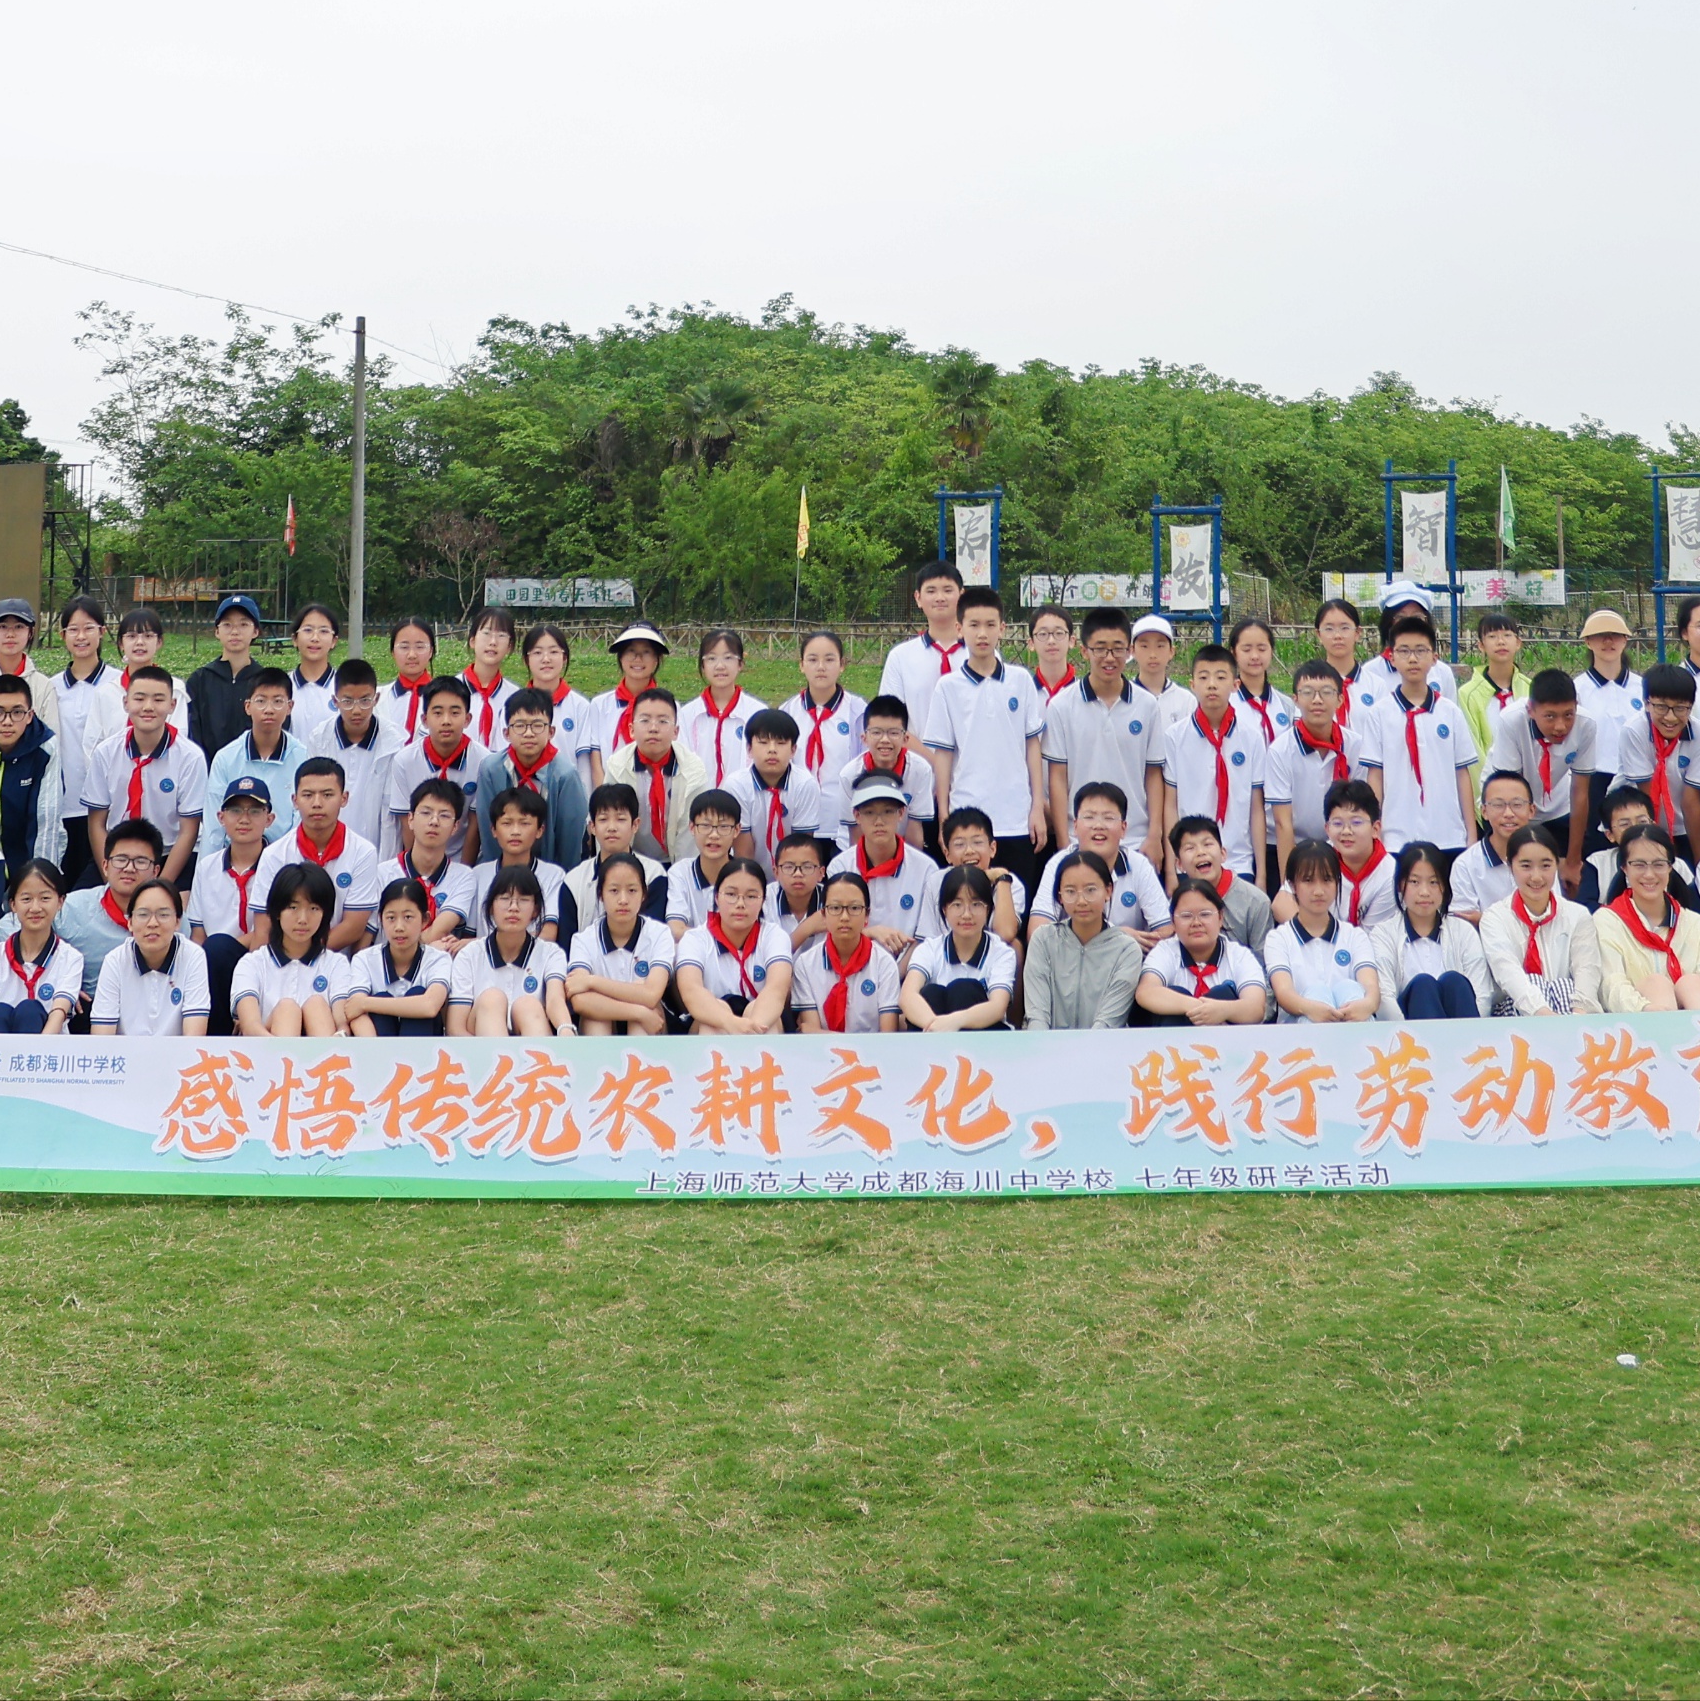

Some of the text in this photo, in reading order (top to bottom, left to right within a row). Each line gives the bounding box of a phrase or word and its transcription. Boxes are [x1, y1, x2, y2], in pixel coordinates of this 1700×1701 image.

[957, 509, 990, 561] 启
[1405, 503, 1445, 557] 智
[1172, 551, 1208, 601] 发
[9, 1053, 127, 1074] 成都海川中学校
[636, 1162, 1391, 1193] 上海师范大学成都海川中学校 七年级研学活动
